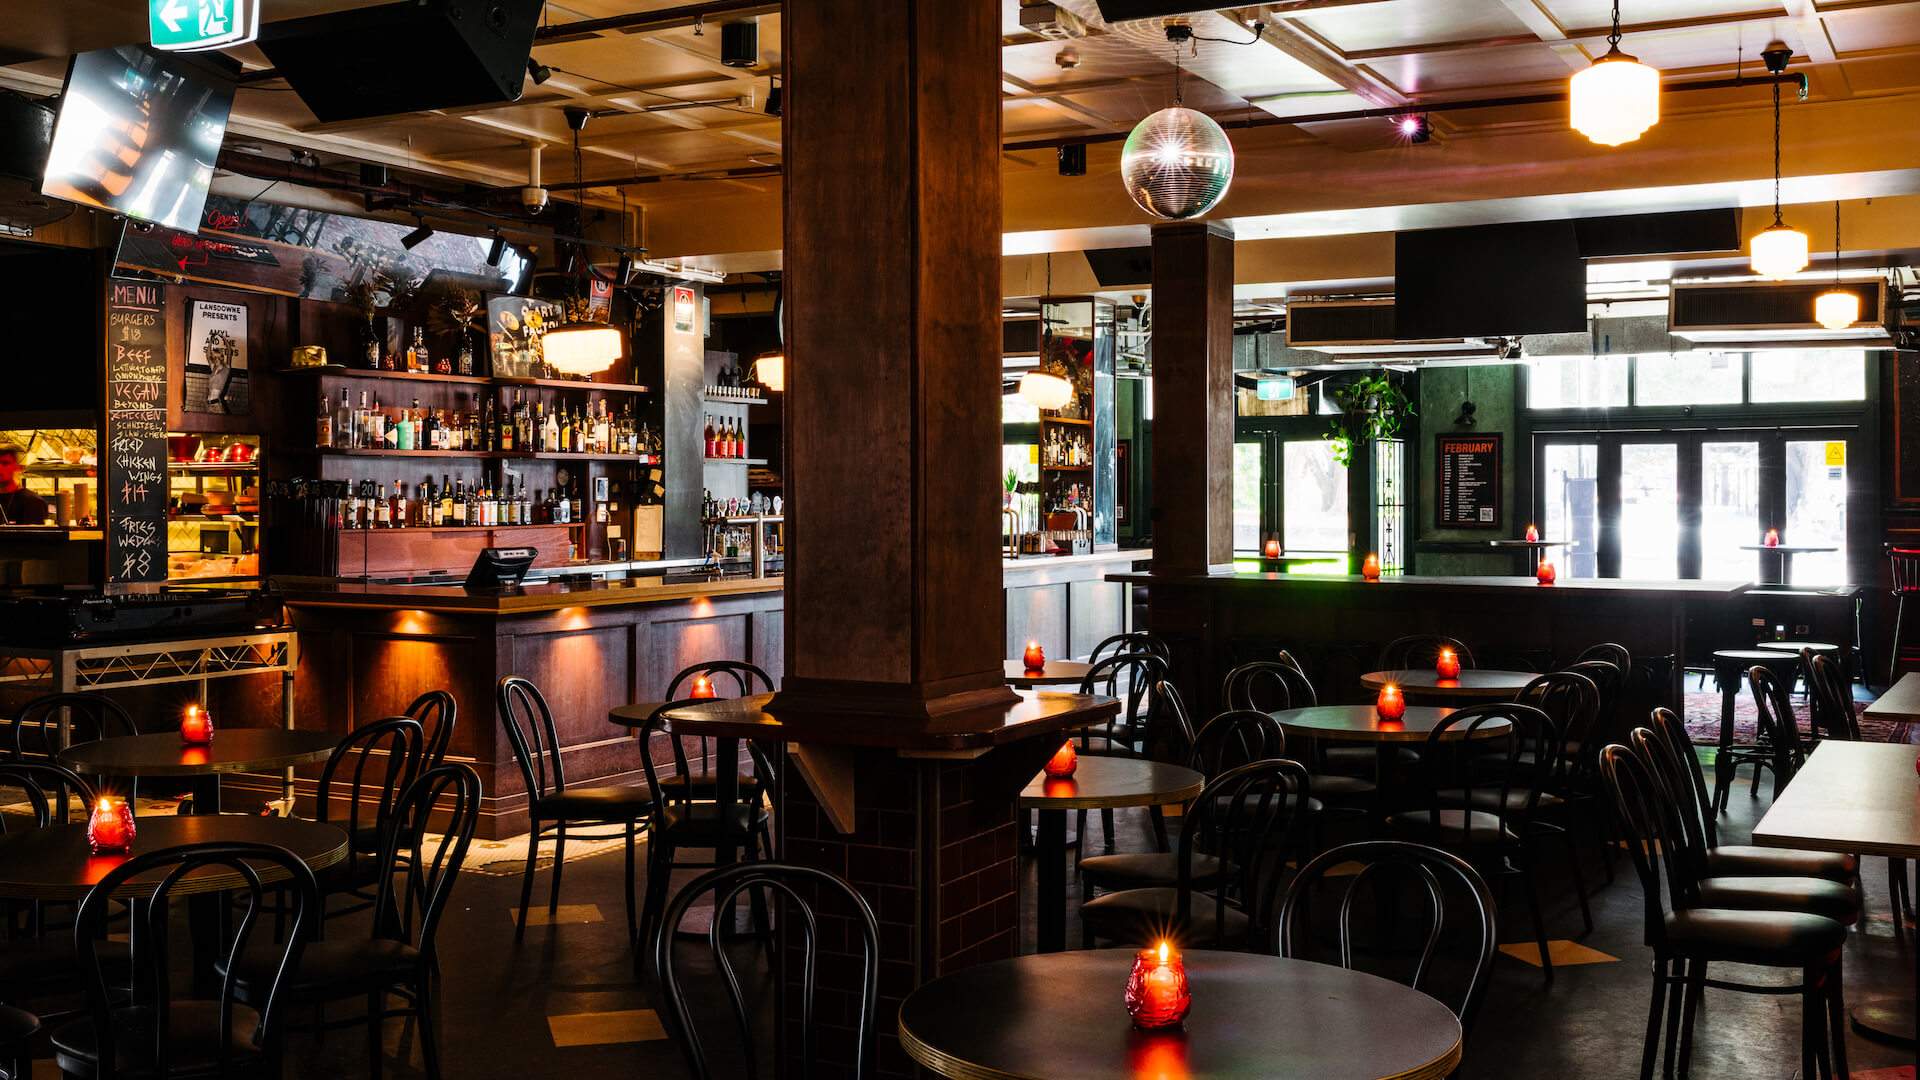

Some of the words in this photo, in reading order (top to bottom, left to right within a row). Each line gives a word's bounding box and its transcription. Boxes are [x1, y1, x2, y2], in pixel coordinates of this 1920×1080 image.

[114, 285, 156, 305] MENU
[200, 304, 241, 314] LANSDOWNE
[202, 311, 238, 321] PRESENTS
[110, 313, 156, 326] BURGERS
[113, 343, 152, 365] BEEF
[115, 383, 159, 401] VEGAN
[113, 399, 154, 410] BEYOND
[111, 410, 161, 421] CHICKEN
[110, 437, 144, 453] FRIED
[1444, 443, 1494, 454] FEBRUARY
[116, 453, 156, 471] CHICKEN
[128, 470, 162, 485] WINGS
[121, 480, 149, 505] $14
[361, 484, 373, 496] 20
[120, 517, 156, 537] FRIES
